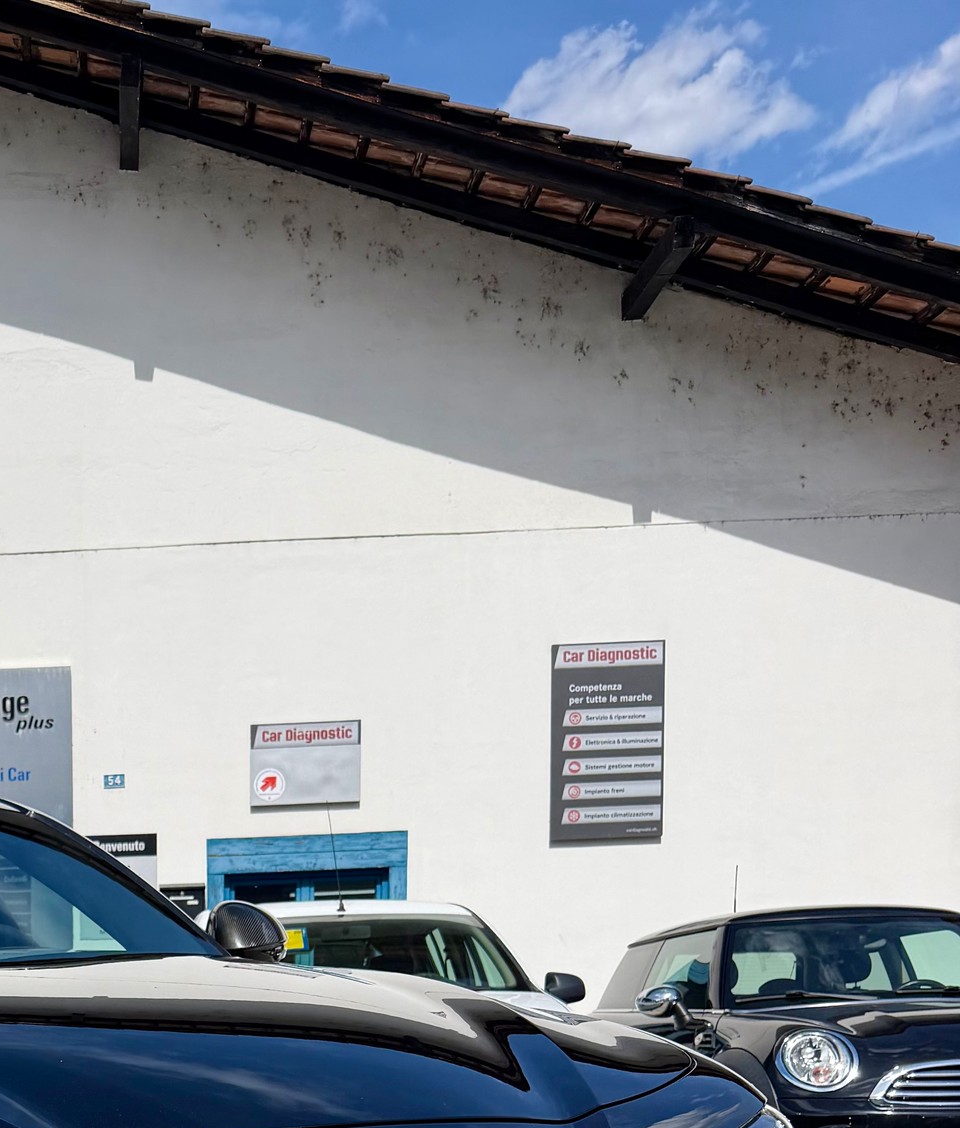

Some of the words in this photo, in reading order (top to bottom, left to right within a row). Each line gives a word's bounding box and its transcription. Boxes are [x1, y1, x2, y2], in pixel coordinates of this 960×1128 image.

[563, 650, 585, 663] Car
[587, 645, 657, 664] Diagnostic
[568, 683, 622, 694] Competenza
[568, 697, 584, 706] per
[586, 695, 607, 704] tutte
[609, 694, 618, 703] le
[620, 693, 652, 703] marche
[16, 715, 54, 733] plus
[262, 729, 282, 743] Car
[285, 725, 353, 744] Diagnostic
[7, 767, 31, 782] Car
[107, 775, 121, 786] 54
[584, 788, 610, 796] Impianto
[584, 812, 610, 820] Impianto
